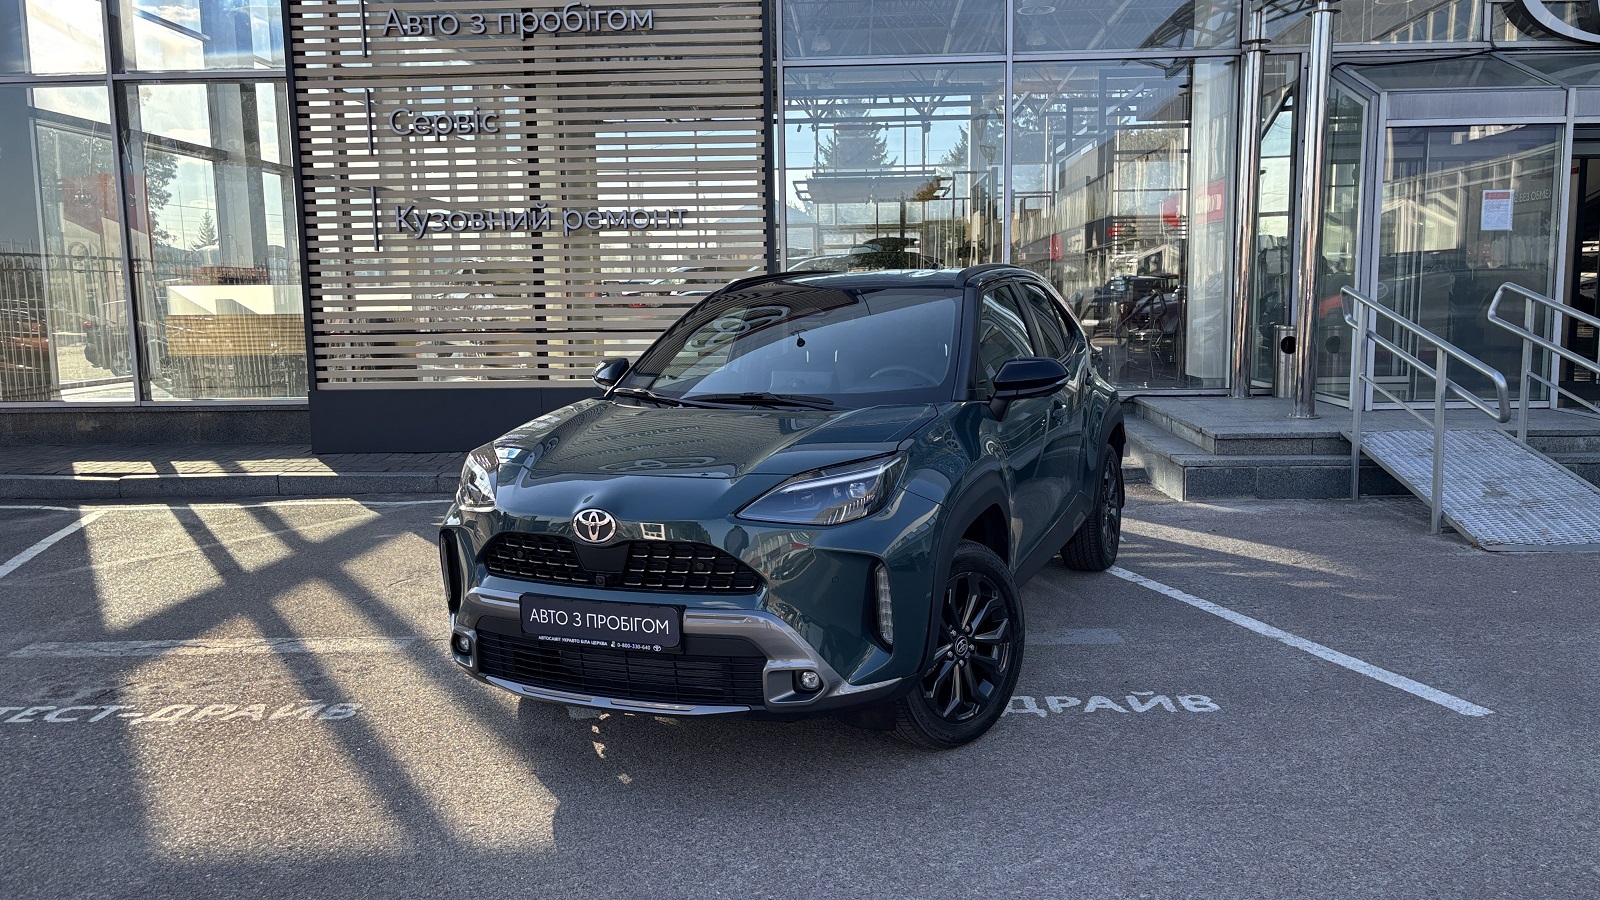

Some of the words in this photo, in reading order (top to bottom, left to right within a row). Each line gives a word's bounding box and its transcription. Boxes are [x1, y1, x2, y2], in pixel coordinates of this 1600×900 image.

[382, 8, 460, 37] Авто
[469, 13, 487, 35] з
[498, 2, 654, 41] пробігом
[388, 106, 501, 142] Сервіс
[394, 203, 551, 239] Кузовний
[563, 208, 688, 237] ремонт
[529, 608, 568, 626] АВТО
[572, 612, 582, 627] З
[586, 613, 669, 635] ПРОБІГОМ
